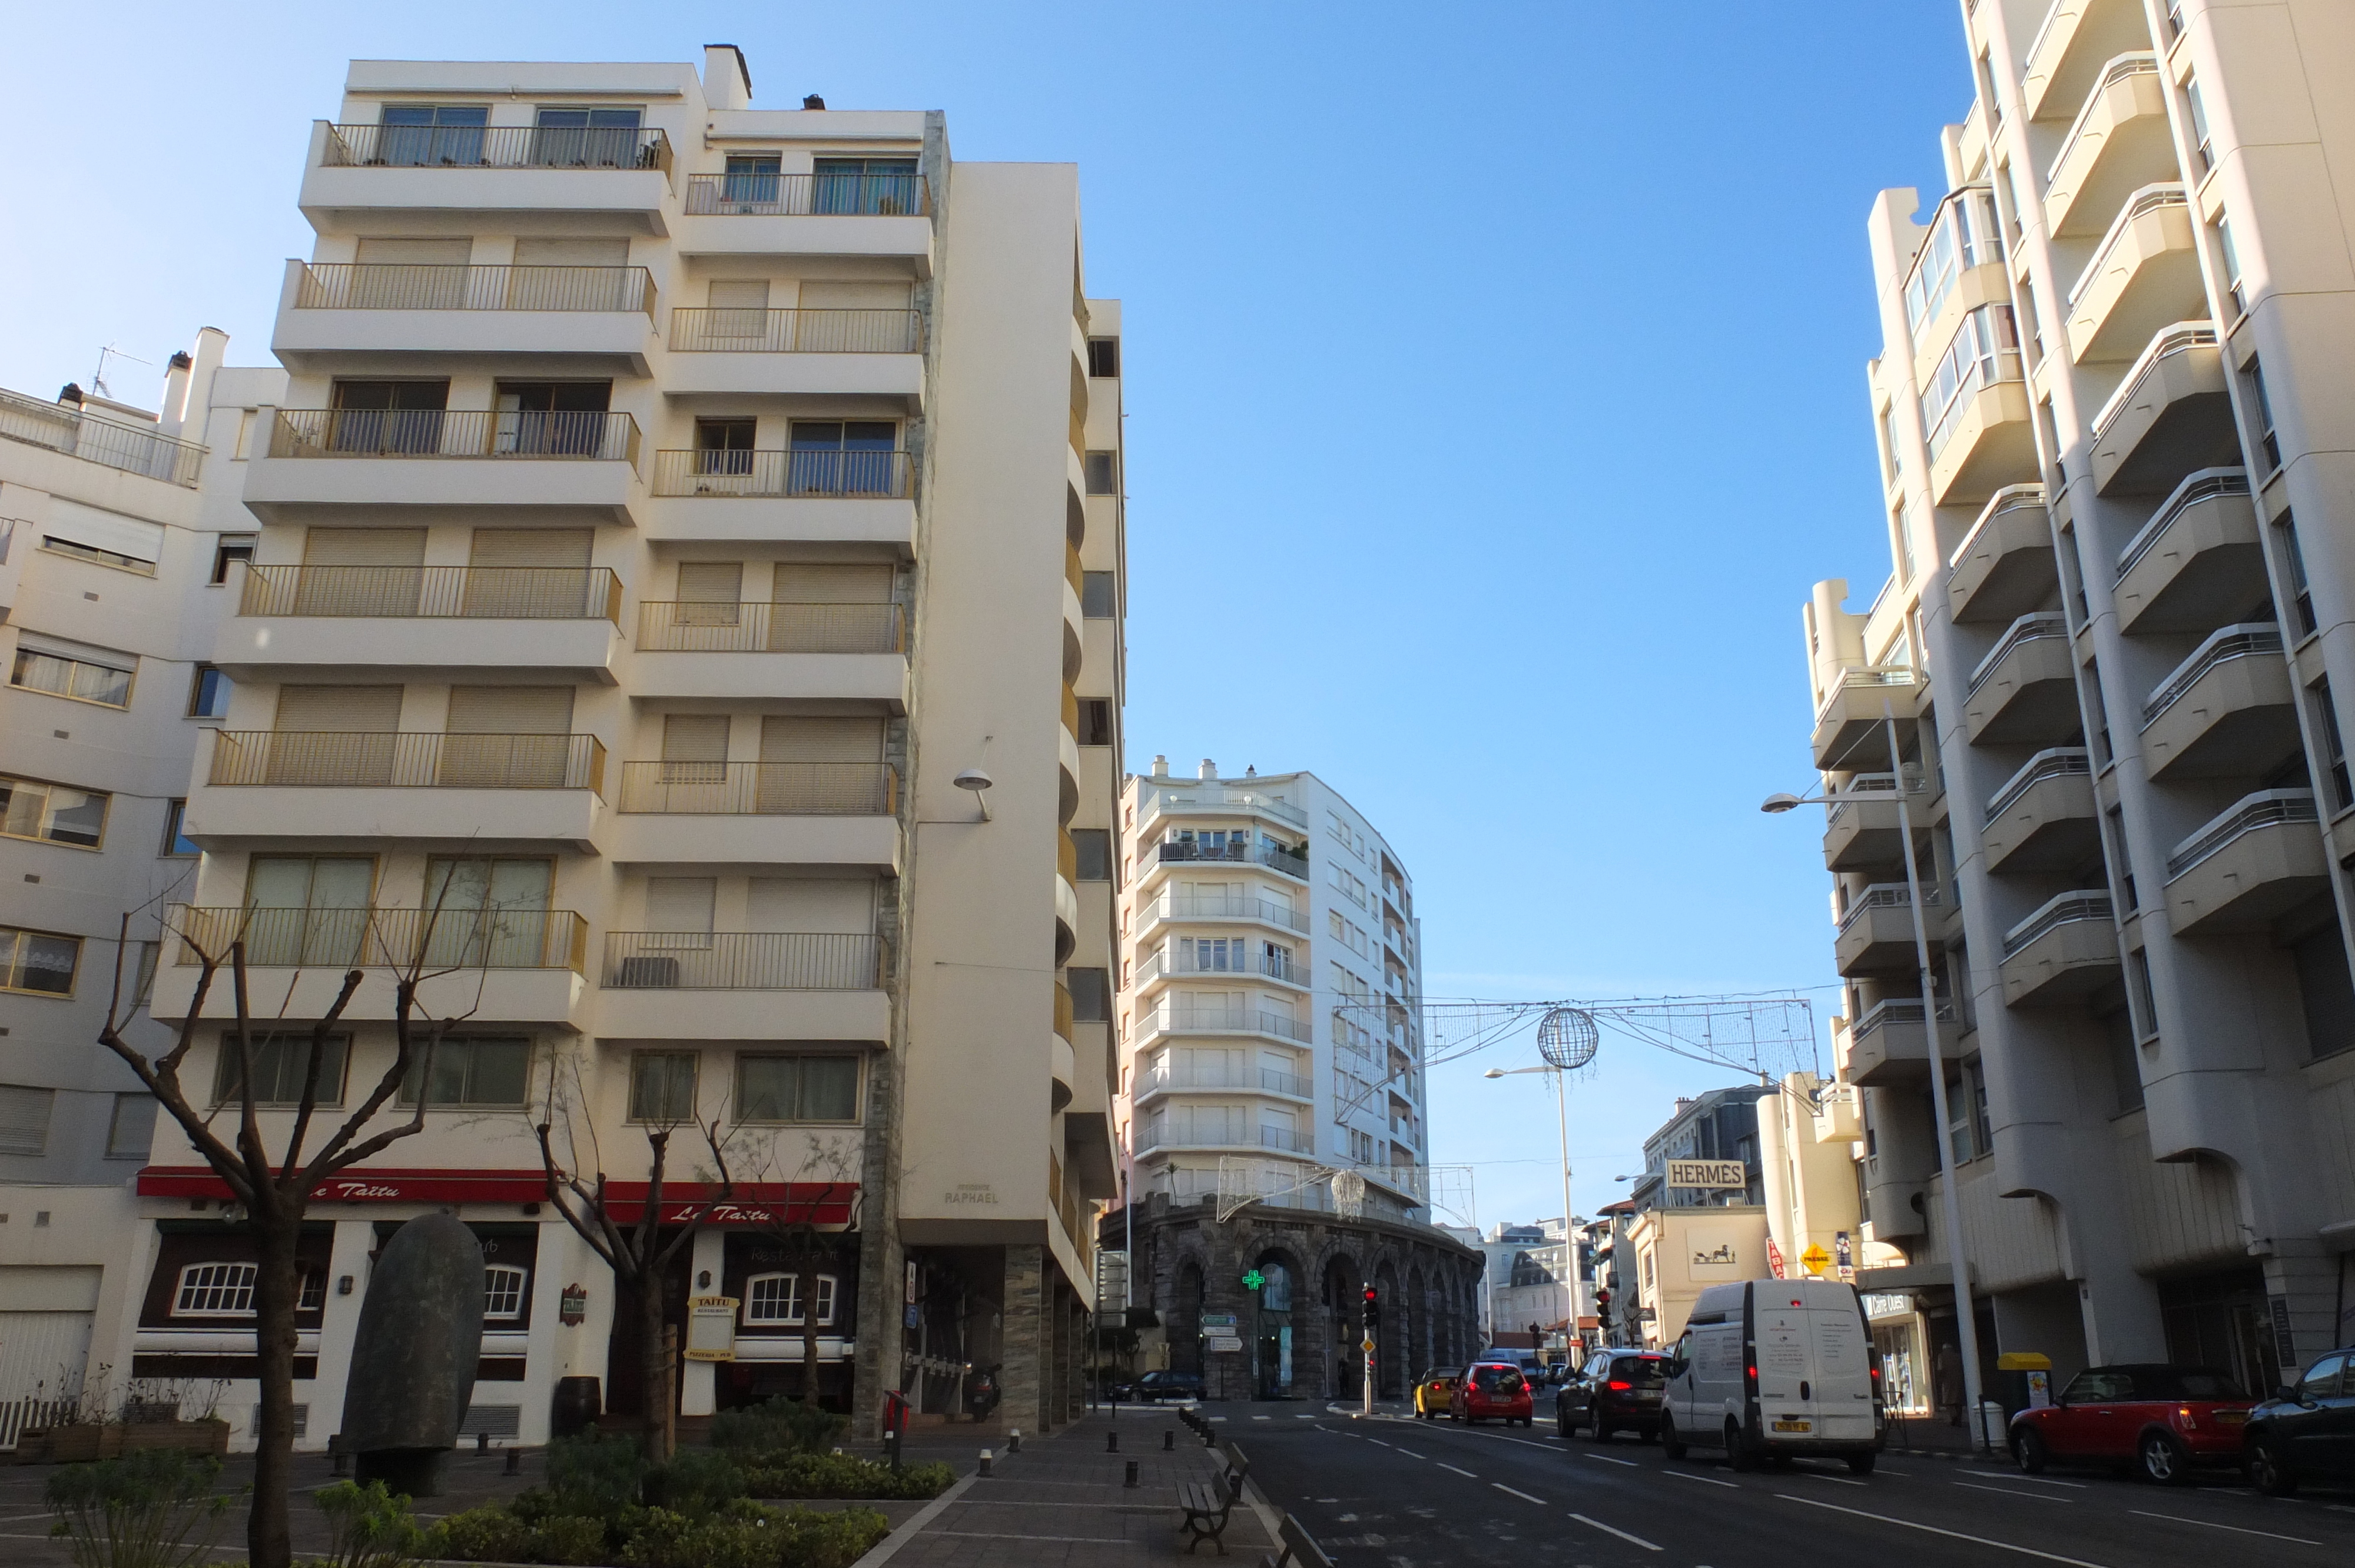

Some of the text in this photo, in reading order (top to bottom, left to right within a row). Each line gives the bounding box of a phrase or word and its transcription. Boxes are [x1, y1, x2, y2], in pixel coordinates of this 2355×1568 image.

[310, 1187, 328, 1197] e
[945, 1192, 999, 1204] RAPHAEL
[698, 1297, 730, 1307] TAÏTU
